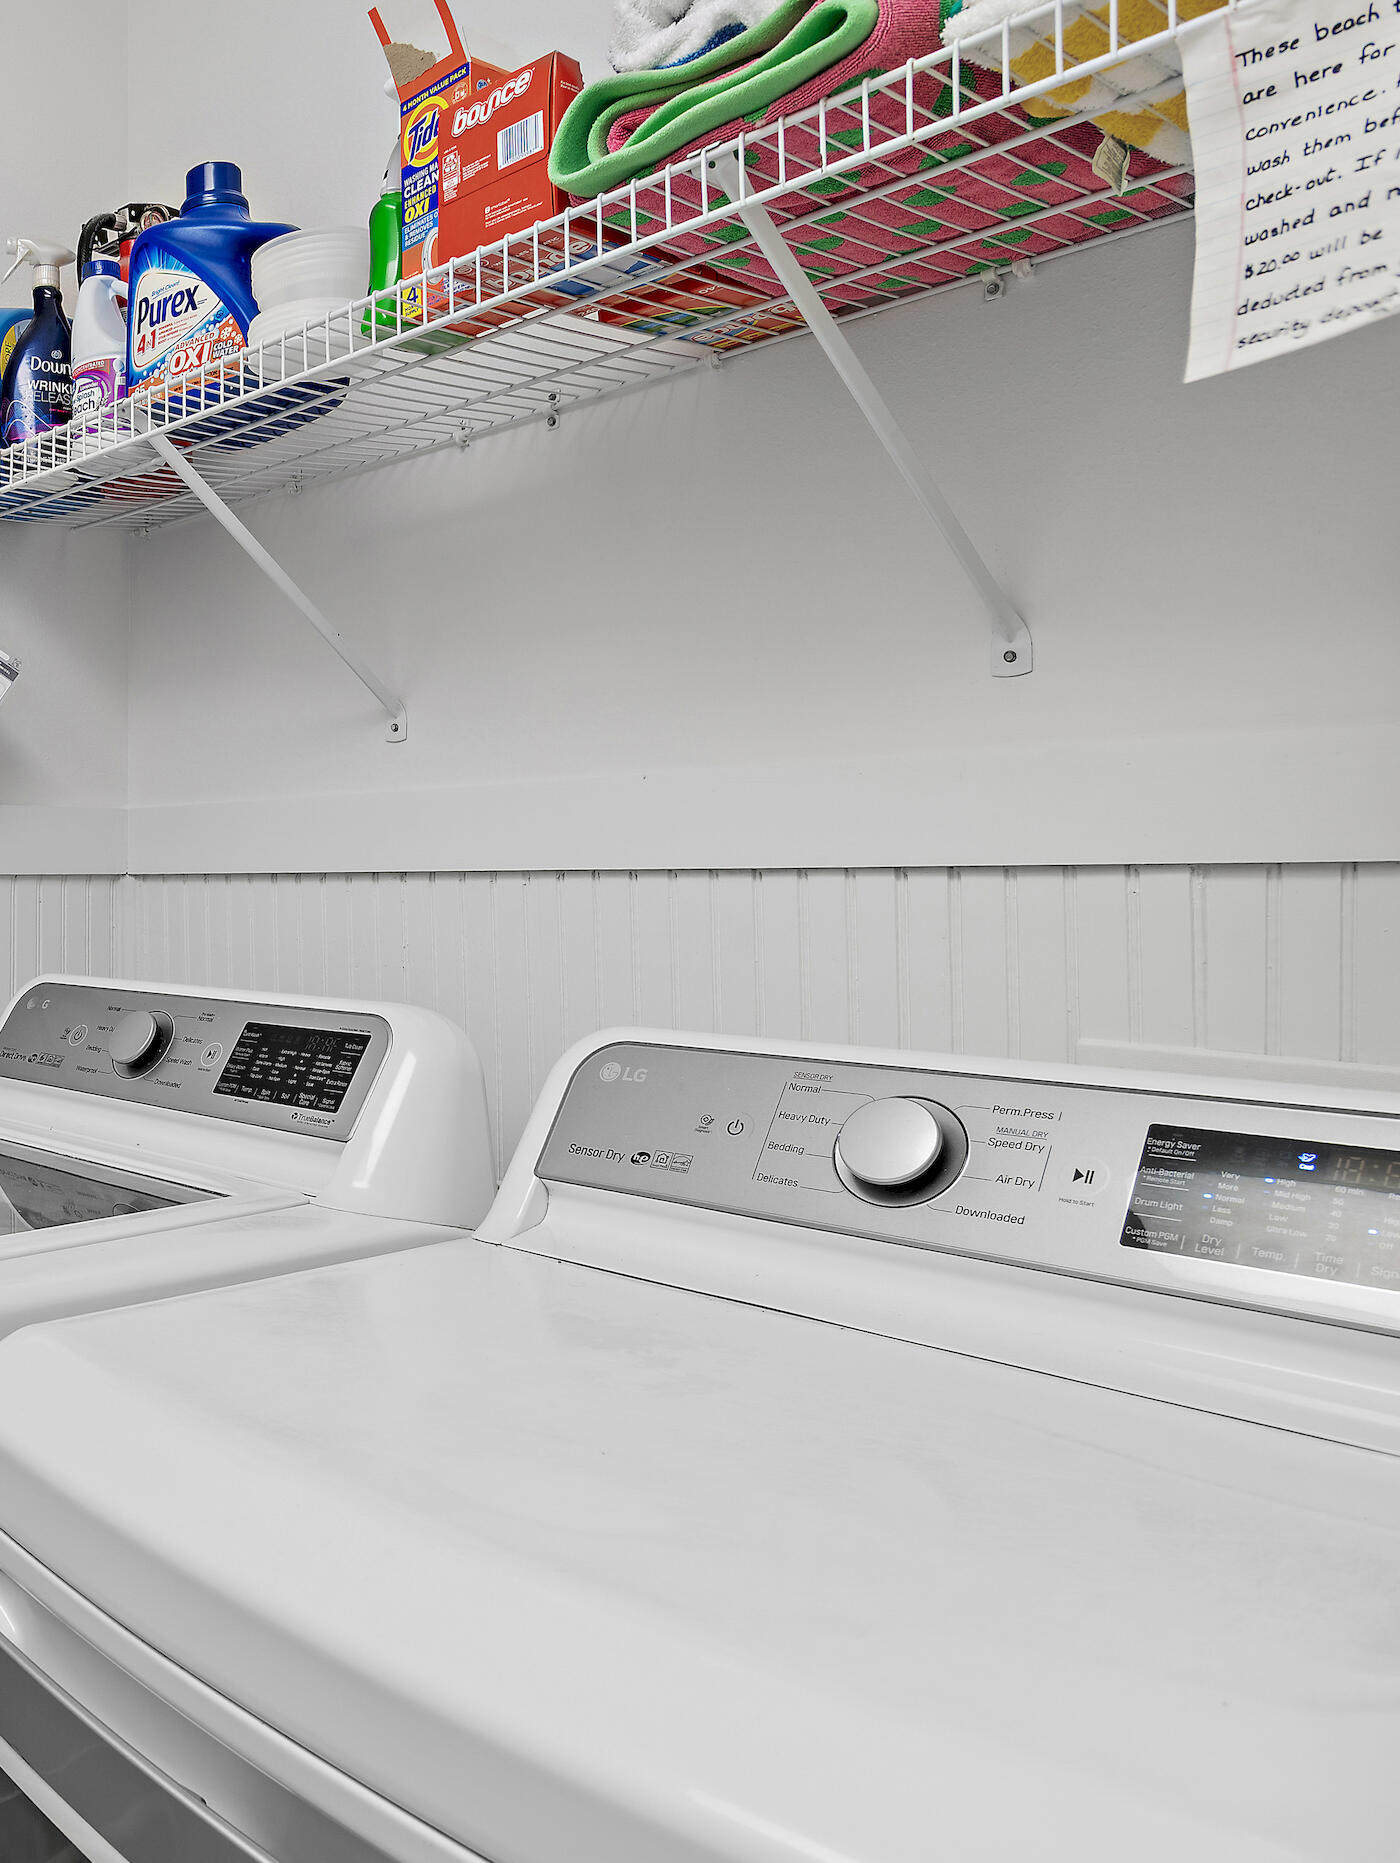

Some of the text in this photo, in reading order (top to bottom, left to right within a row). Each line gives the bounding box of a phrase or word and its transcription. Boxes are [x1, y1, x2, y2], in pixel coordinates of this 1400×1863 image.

[1234, 2, 1380, 67] These beach
[1242, 42, 1396, 105] are here for
[407, 91, 429, 108] MONTH
[429, 77, 450, 96] VALUE
[450, 66, 468, 83] PACK
[451, 68, 534, 138] bounce
[1245, 89, 1387, 141] convenience.
[1247, 150, 1290, 176] wash
[1303, 133, 1351, 157] them
[403, 165, 429, 187] WASHING
[1245, 148, 1387, 211] check-out. If
[403, 171, 439, 199] CLEAN
[403, 184, 437, 210] ENHANCED
[404, 196, 430, 224] OXI
[1244, 208, 1315, 246] washed
[1329, 190, 1372, 218] and
[1309, 235, 1347, 260] will
[1360, 230, 1383, 246] be
[407, 286, 419, 303] 4
[1236, 266, 1387, 317] deducted from
[136, 284, 200, 335] Purex
[174, 332, 215, 351] ADVANCED
[213, 340, 234, 351] COLD
[168, 341, 213, 376] OXI
[212, 345, 239, 359] WATER
[621, 1067, 648, 1083] LG
[793, 1071, 834, 1081] SENSOR DRY
[788, 1082, 822, 1093] Normal
[778, 1110, 832, 1127] Heavy Duty
[992, 1105, 1055, 1120] Perm.Press
[996, 1126, 1049, 1139] MANUAL DRY
[767, 1141, 805, 1156] Bedding
[987, 1137, 1046, 1154] Speed Dry
[1146, 1137, 1202, 1151] Energy Saver
[1151, 1146, 1195, 1157] Default On/Off
[568, 1143, 626, 1164] Sensor Dry
[756, 1172, 799, 1188] Delicates
[1140, 1166, 1195, 1180] Anti-Bacterial
[1221, 1171, 1240, 1181] Very
[995, 1174, 1036, 1190] Air Dry
[1217, 1182, 1239, 1192] More
[1276, 1178, 1297, 1189] High
[1274, 1189, 1312, 1203] Mid High
[1134, 1197, 1184, 1212] Drum Light
[955, 1204, 1026, 1226] Downloaded
[1125, 1226, 1179, 1242] Custom PGM
[1201, 1234, 1222, 1247] Dry
[1194, 1243, 1225, 1257] Level
[1251, 1246, 1286, 1261] Temp.
[1313, 1251, 1344, 1265] Time
[1315, 1263, 1338, 1276] Dry
